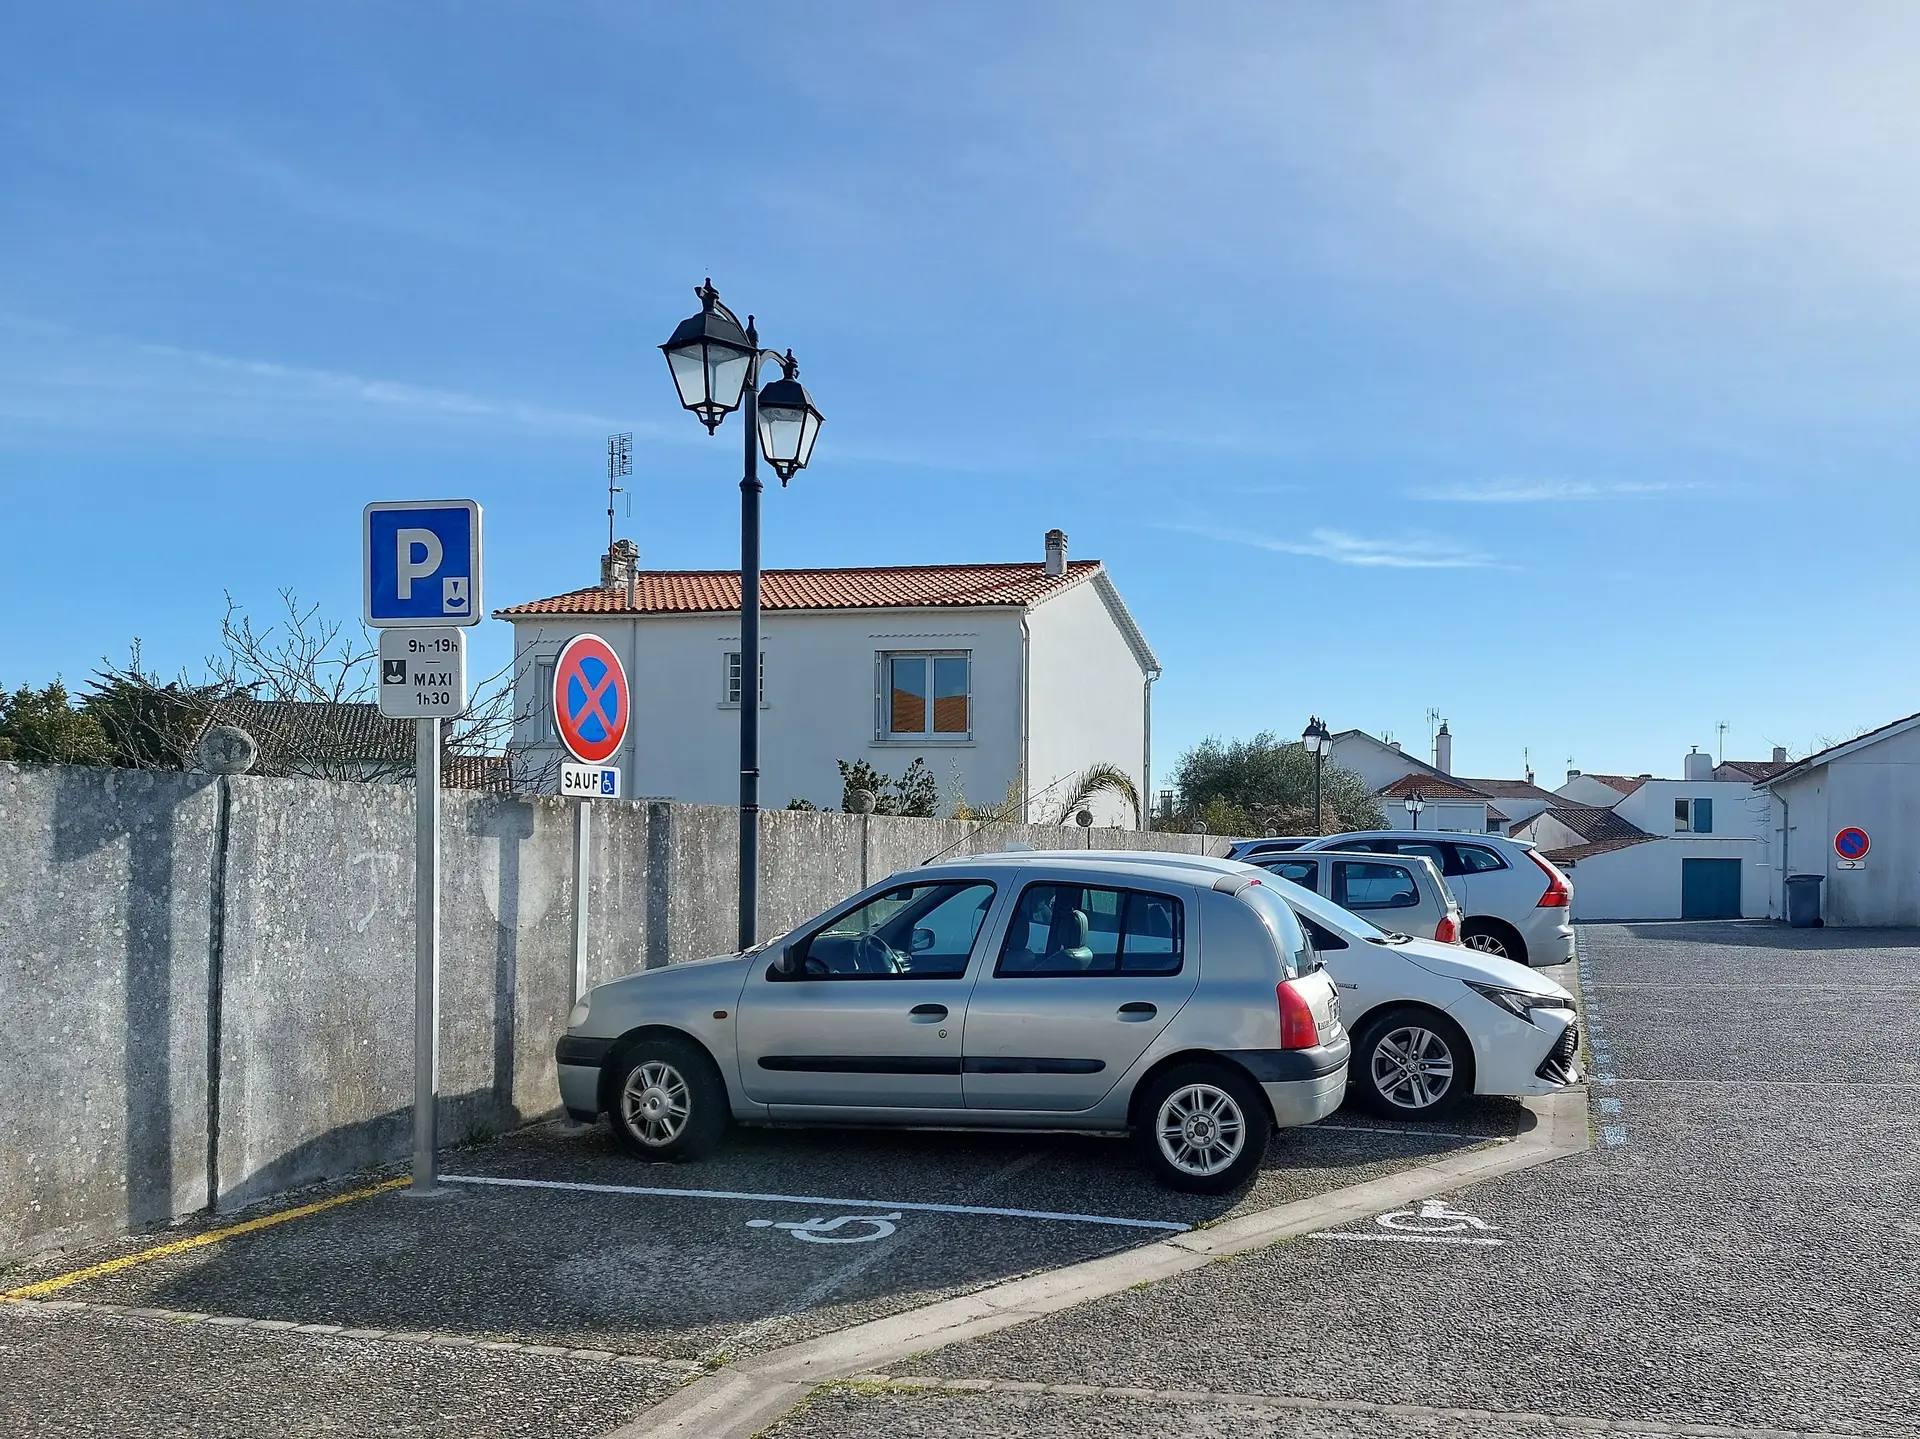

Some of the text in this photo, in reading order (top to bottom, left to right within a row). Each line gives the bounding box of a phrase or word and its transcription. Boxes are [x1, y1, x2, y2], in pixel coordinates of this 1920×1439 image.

[397, 528, 443, 600] P
[408, 639, 458, 653] 9h-19h
[414, 673, 452, 686] MAXI
[416, 692, 450, 705] 1h30
[565, 771, 599, 789] SAUF
